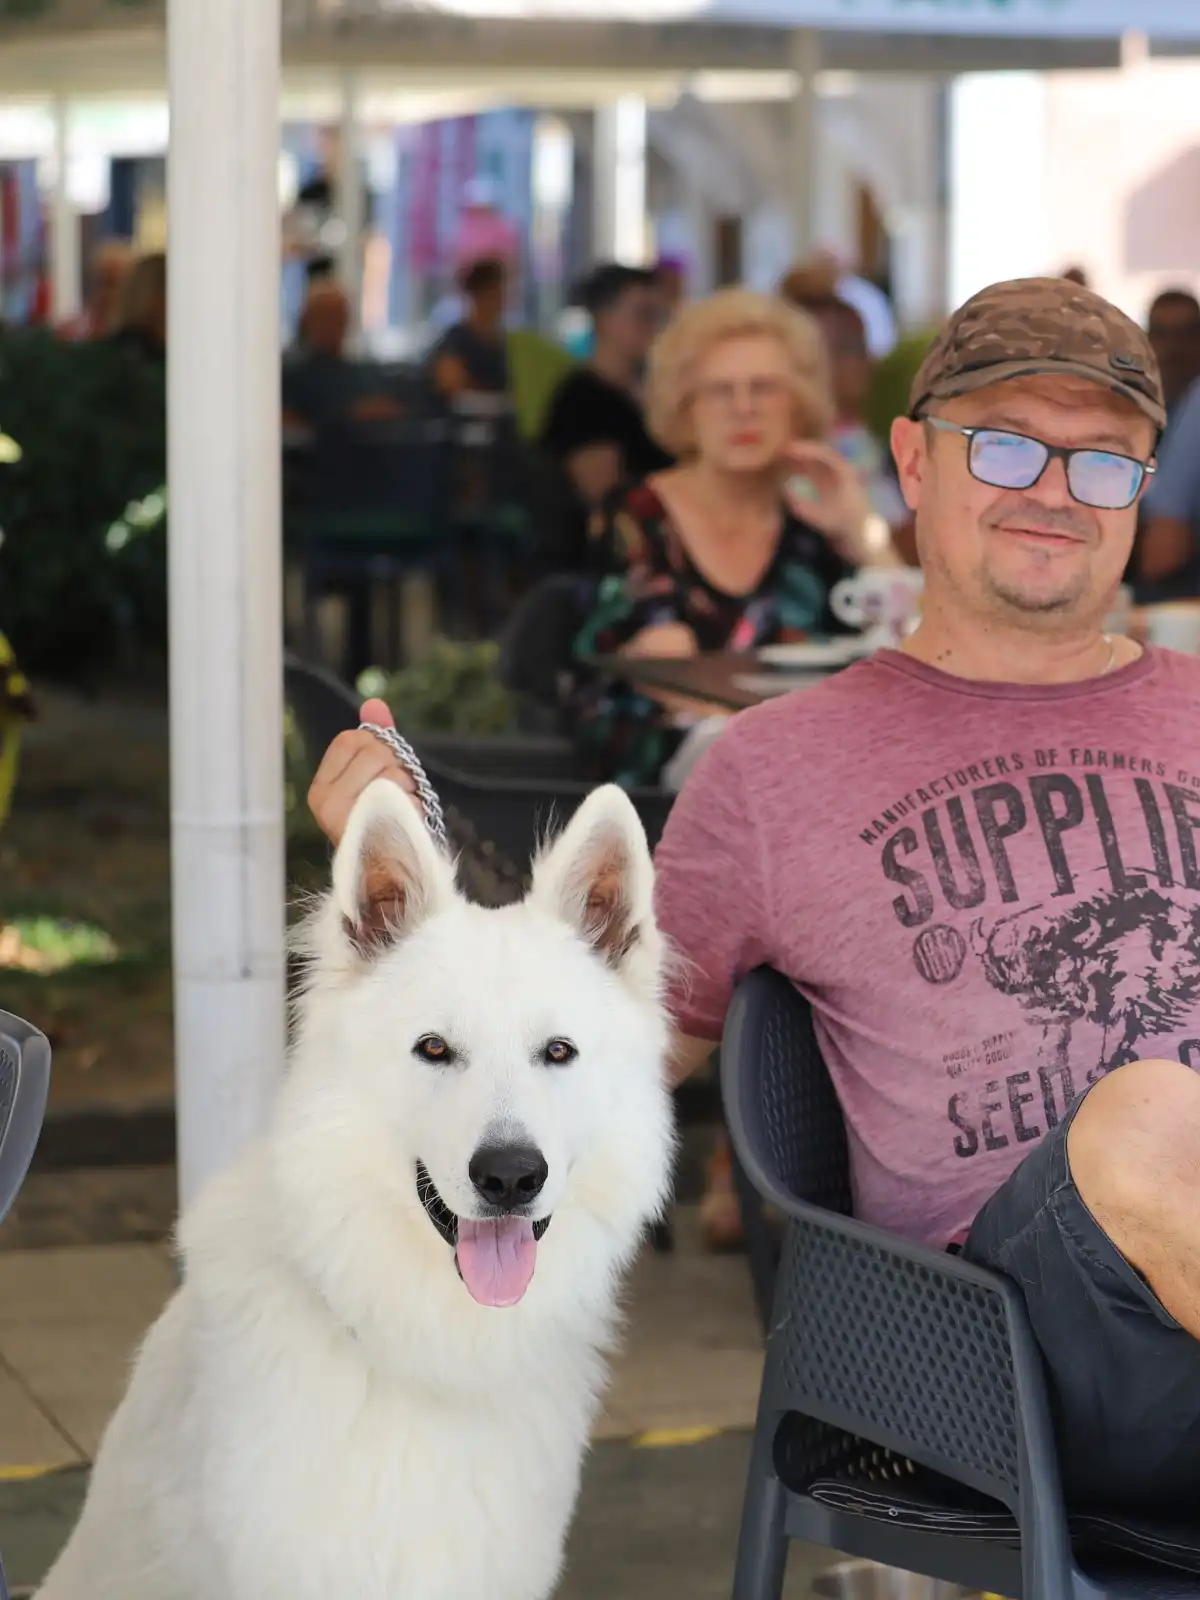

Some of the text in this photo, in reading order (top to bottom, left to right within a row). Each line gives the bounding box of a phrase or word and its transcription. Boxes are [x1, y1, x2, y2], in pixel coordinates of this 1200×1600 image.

[859, 752, 1024, 845] MANUFACTURERS
[1035, 749, 1057, 768] OF
[1071, 748, 1166, 777] FARMERS
[948, 1065, 1076, 1158] SEED
